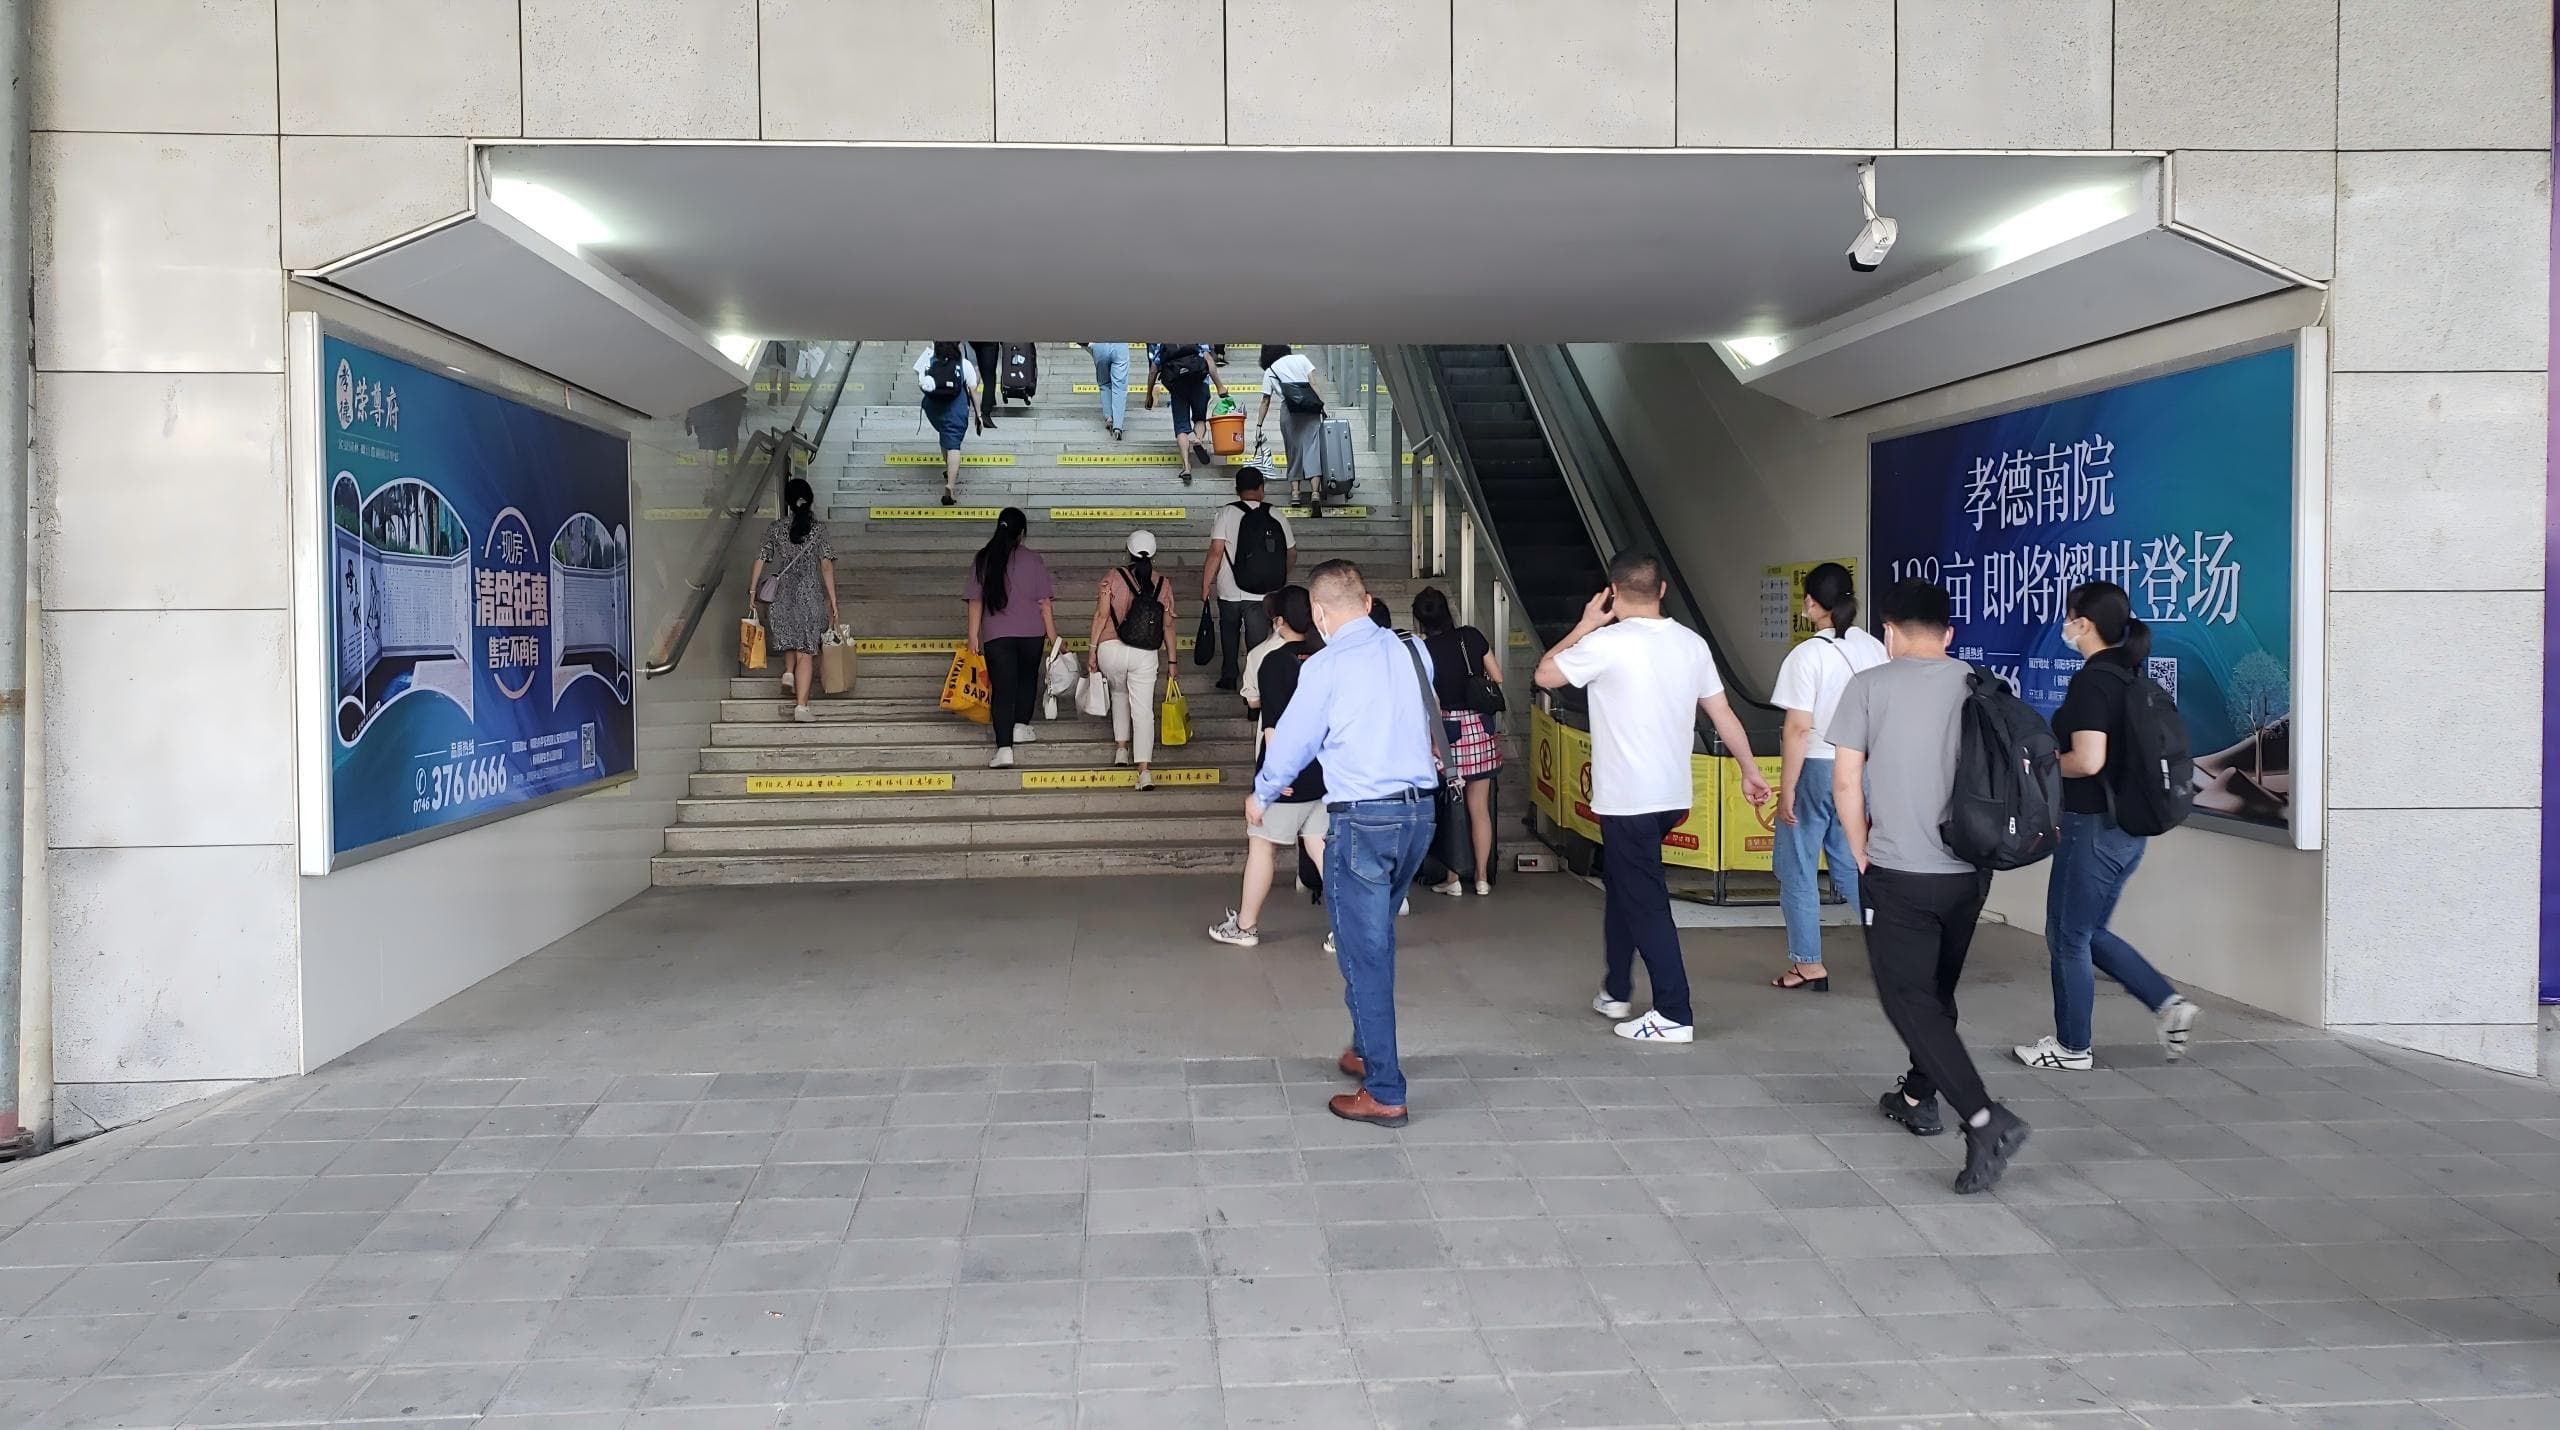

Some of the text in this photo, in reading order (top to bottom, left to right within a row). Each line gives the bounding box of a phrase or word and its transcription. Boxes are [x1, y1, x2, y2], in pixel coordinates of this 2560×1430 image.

[1963, 433, 2116, 532] 孝德南院
[501, 530, 523, 565] 现房
[413, 796, 430, 814] 0746
[431, 762, 465, 811] 376
[467, 753, 507, 801] 6666
